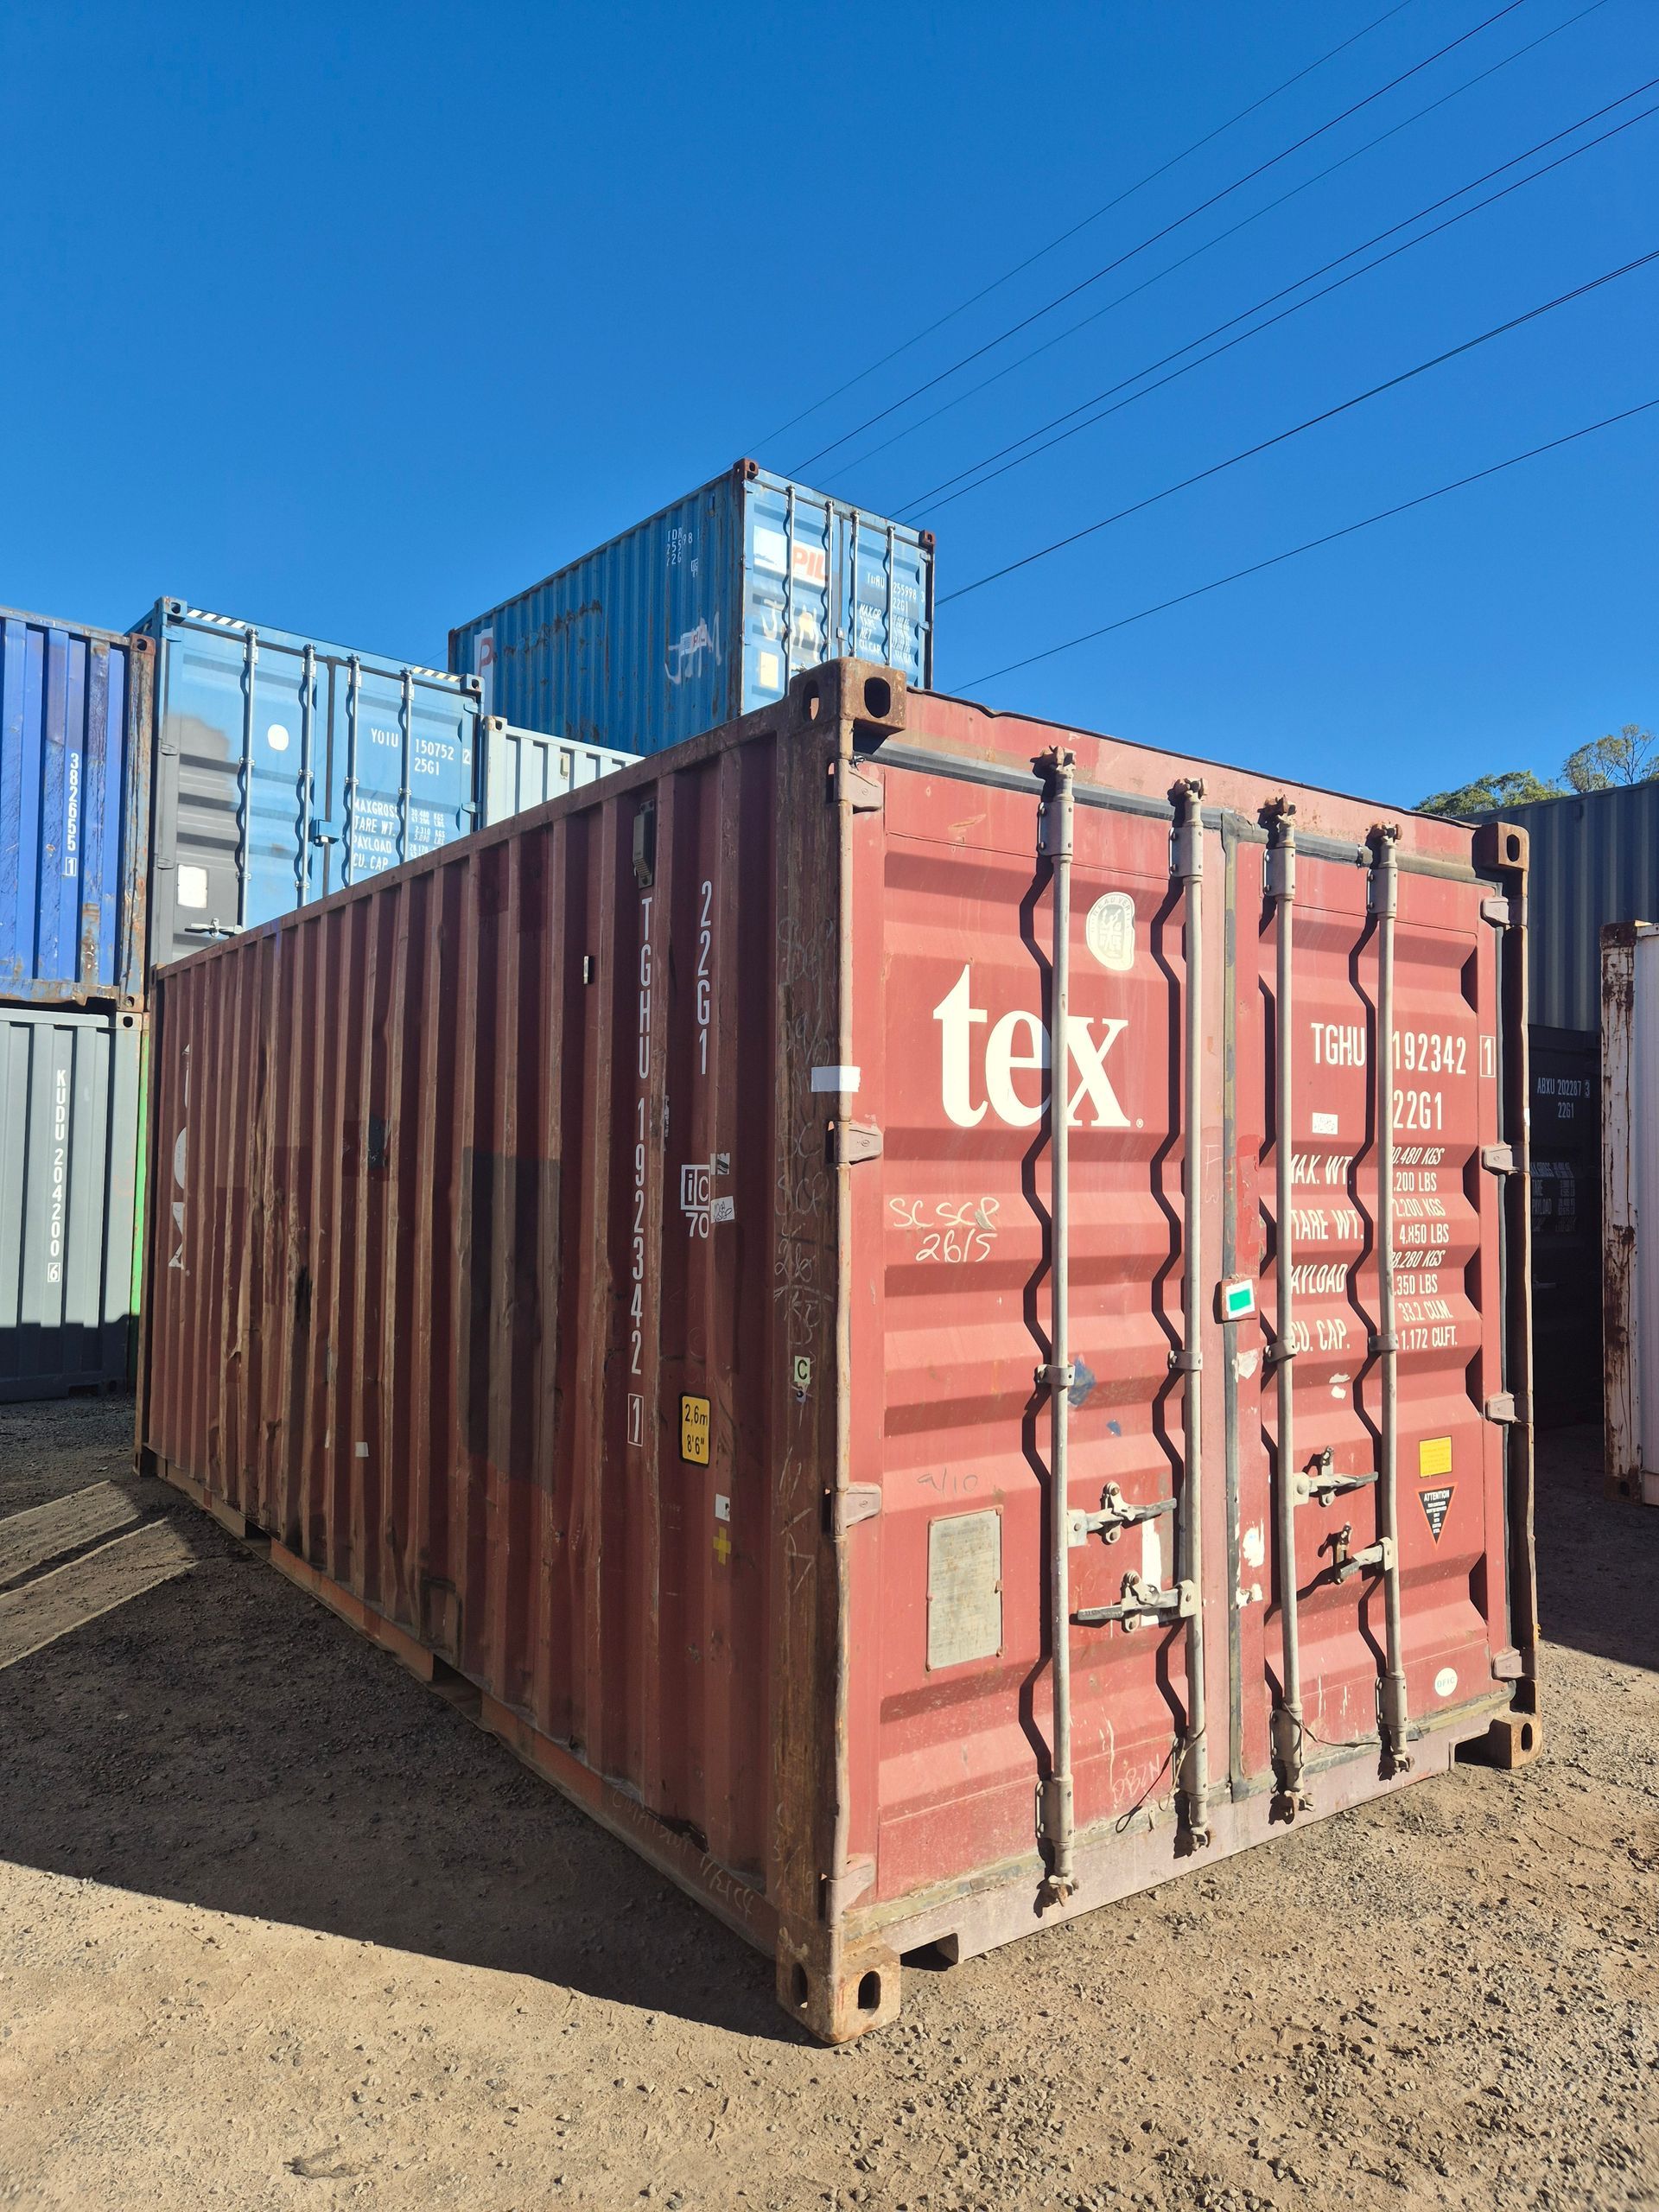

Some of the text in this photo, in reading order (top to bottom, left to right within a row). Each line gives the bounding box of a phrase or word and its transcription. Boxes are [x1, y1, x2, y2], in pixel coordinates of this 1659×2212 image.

[793, 546, 828, 582] PIL
[893, 582, 917, 600] 255998
[893, 598, 909, 615] 22G1
[371, 728, 471, 765] YOIU 150752 2
[414, 758, 440, 775] 25G1
[67, 753, 79, 875] 382655 1
[354, 815, 396, 836] TARE WT.
[696, 880, 712, 1075] 22G1
[933, 963, 1130, 1128] tex
[1311, 1022, 1493, 1076] TGHU 192342 1
[1537, 1077, 1554, 1095] ABXU
[1558, 1079, 1581, 1096] 202287
[1393, 1090, 1442, 1130] 22G1
[1393, 1147, 1445, 1166] 0.480 KGS
[48, 1070, 66, 1281] KUDU 204200 6
[631, 897, 652, 1445] TGHU 192342 1
[1419, 1172, 1437, 1192] LBS
[889, 1198, 934, 1228] SC
[1421, 1198, 1446, 1217] KGS
[685, 1212, 709, 1238] 70
[1291, 1210, 1364, 1240] TARE WT.
[1430, 1224, 1449, 1243] LBS
[1393, 1250, 1446, 1268] 8.280 KGS
[1291, 1263, 1348, 1294] AYLOAD
[1419, 1274, 1438, 1294] LBS
[1399, 1302, 1422, 1323] 33.2
[1292, 1319, 1351, 1351] CU. CAP.
[797, 1359, 807, 1380] C
[1423, 1489, 1451, 1503] ATTENTION
